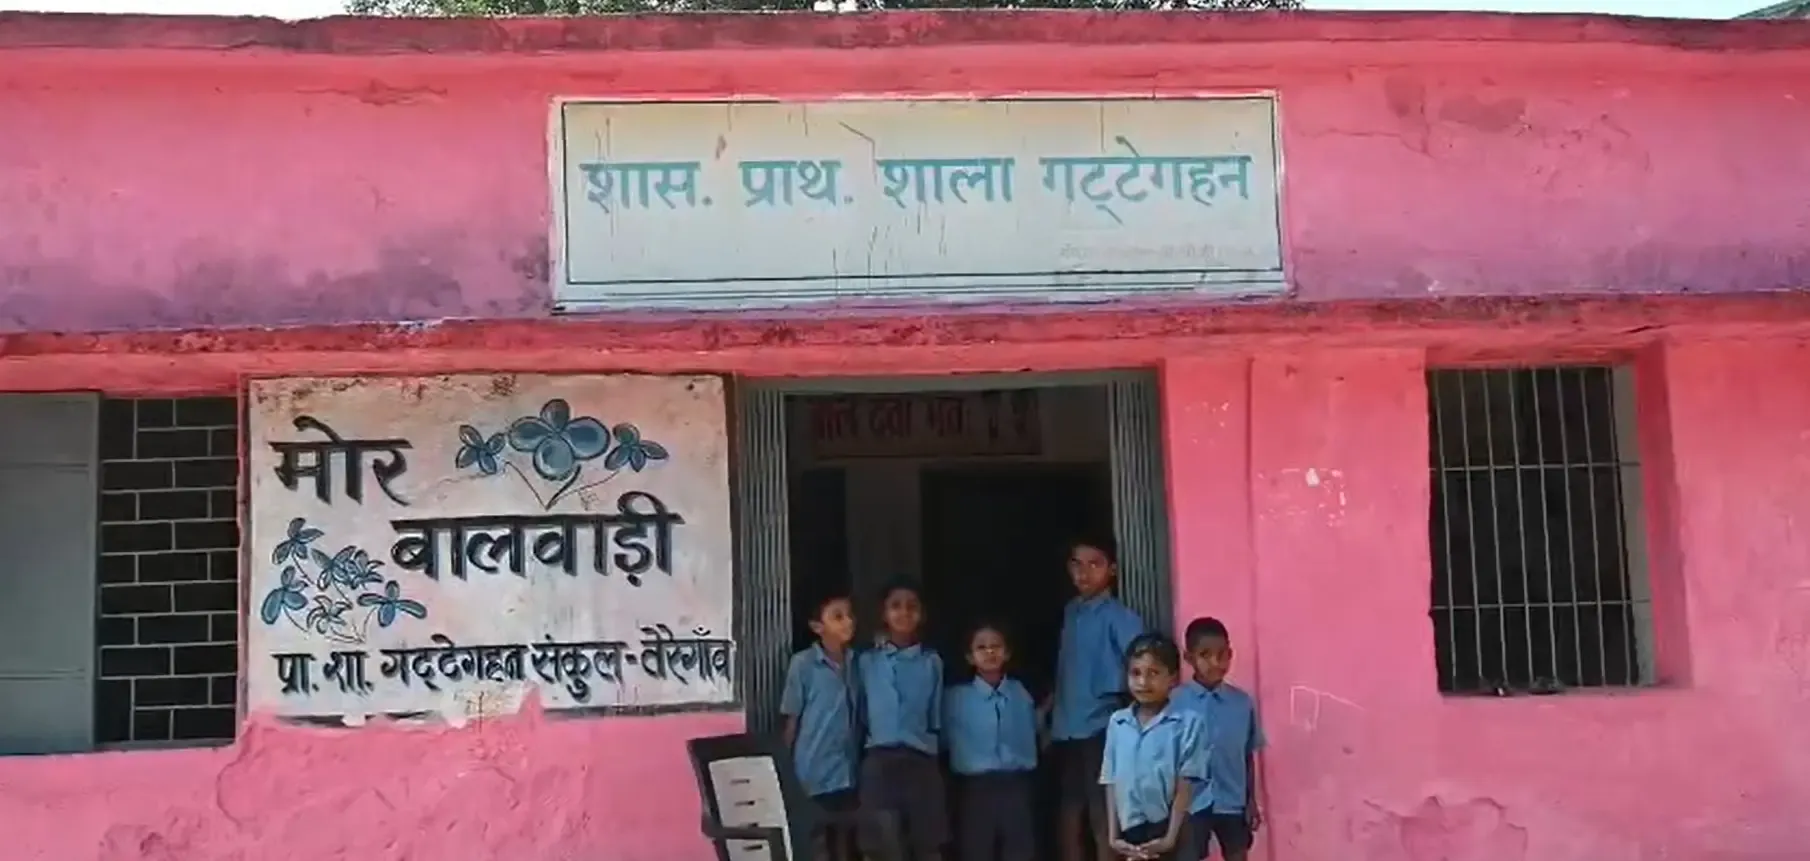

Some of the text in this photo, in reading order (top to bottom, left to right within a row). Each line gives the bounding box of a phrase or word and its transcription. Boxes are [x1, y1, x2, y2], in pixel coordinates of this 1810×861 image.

[578, 135, 1253, 226] शास. प्राथ. शाला गट्टेगहन
[269, 415, 413, 506] मोर
[389, 491, 685, 587] बालवाड़ी
[271, 652, 320, 697] प्रा.
